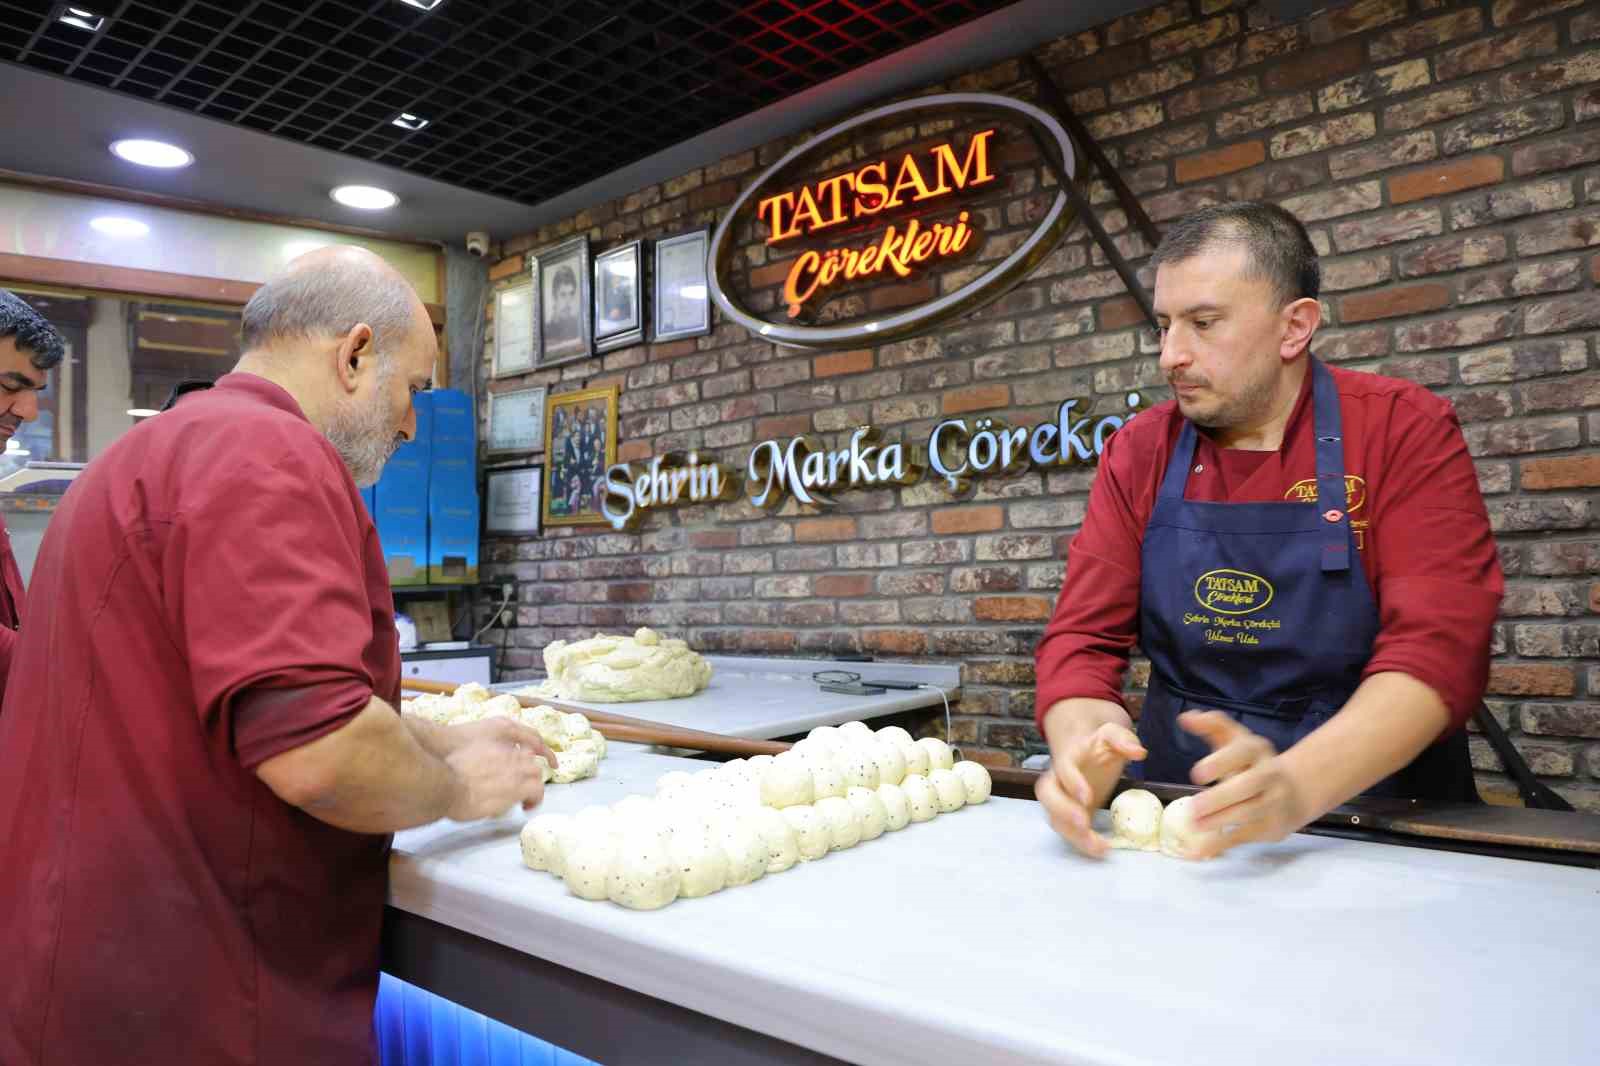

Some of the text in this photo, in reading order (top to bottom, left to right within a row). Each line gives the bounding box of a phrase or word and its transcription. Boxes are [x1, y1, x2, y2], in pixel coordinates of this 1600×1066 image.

[757, 128, 996, 246] TATSAM
[783, 210, 973, 318] Çörekleri
[748, 425, 906, 507] Marka
[1205, 575, 1260, 593] TATSAM
